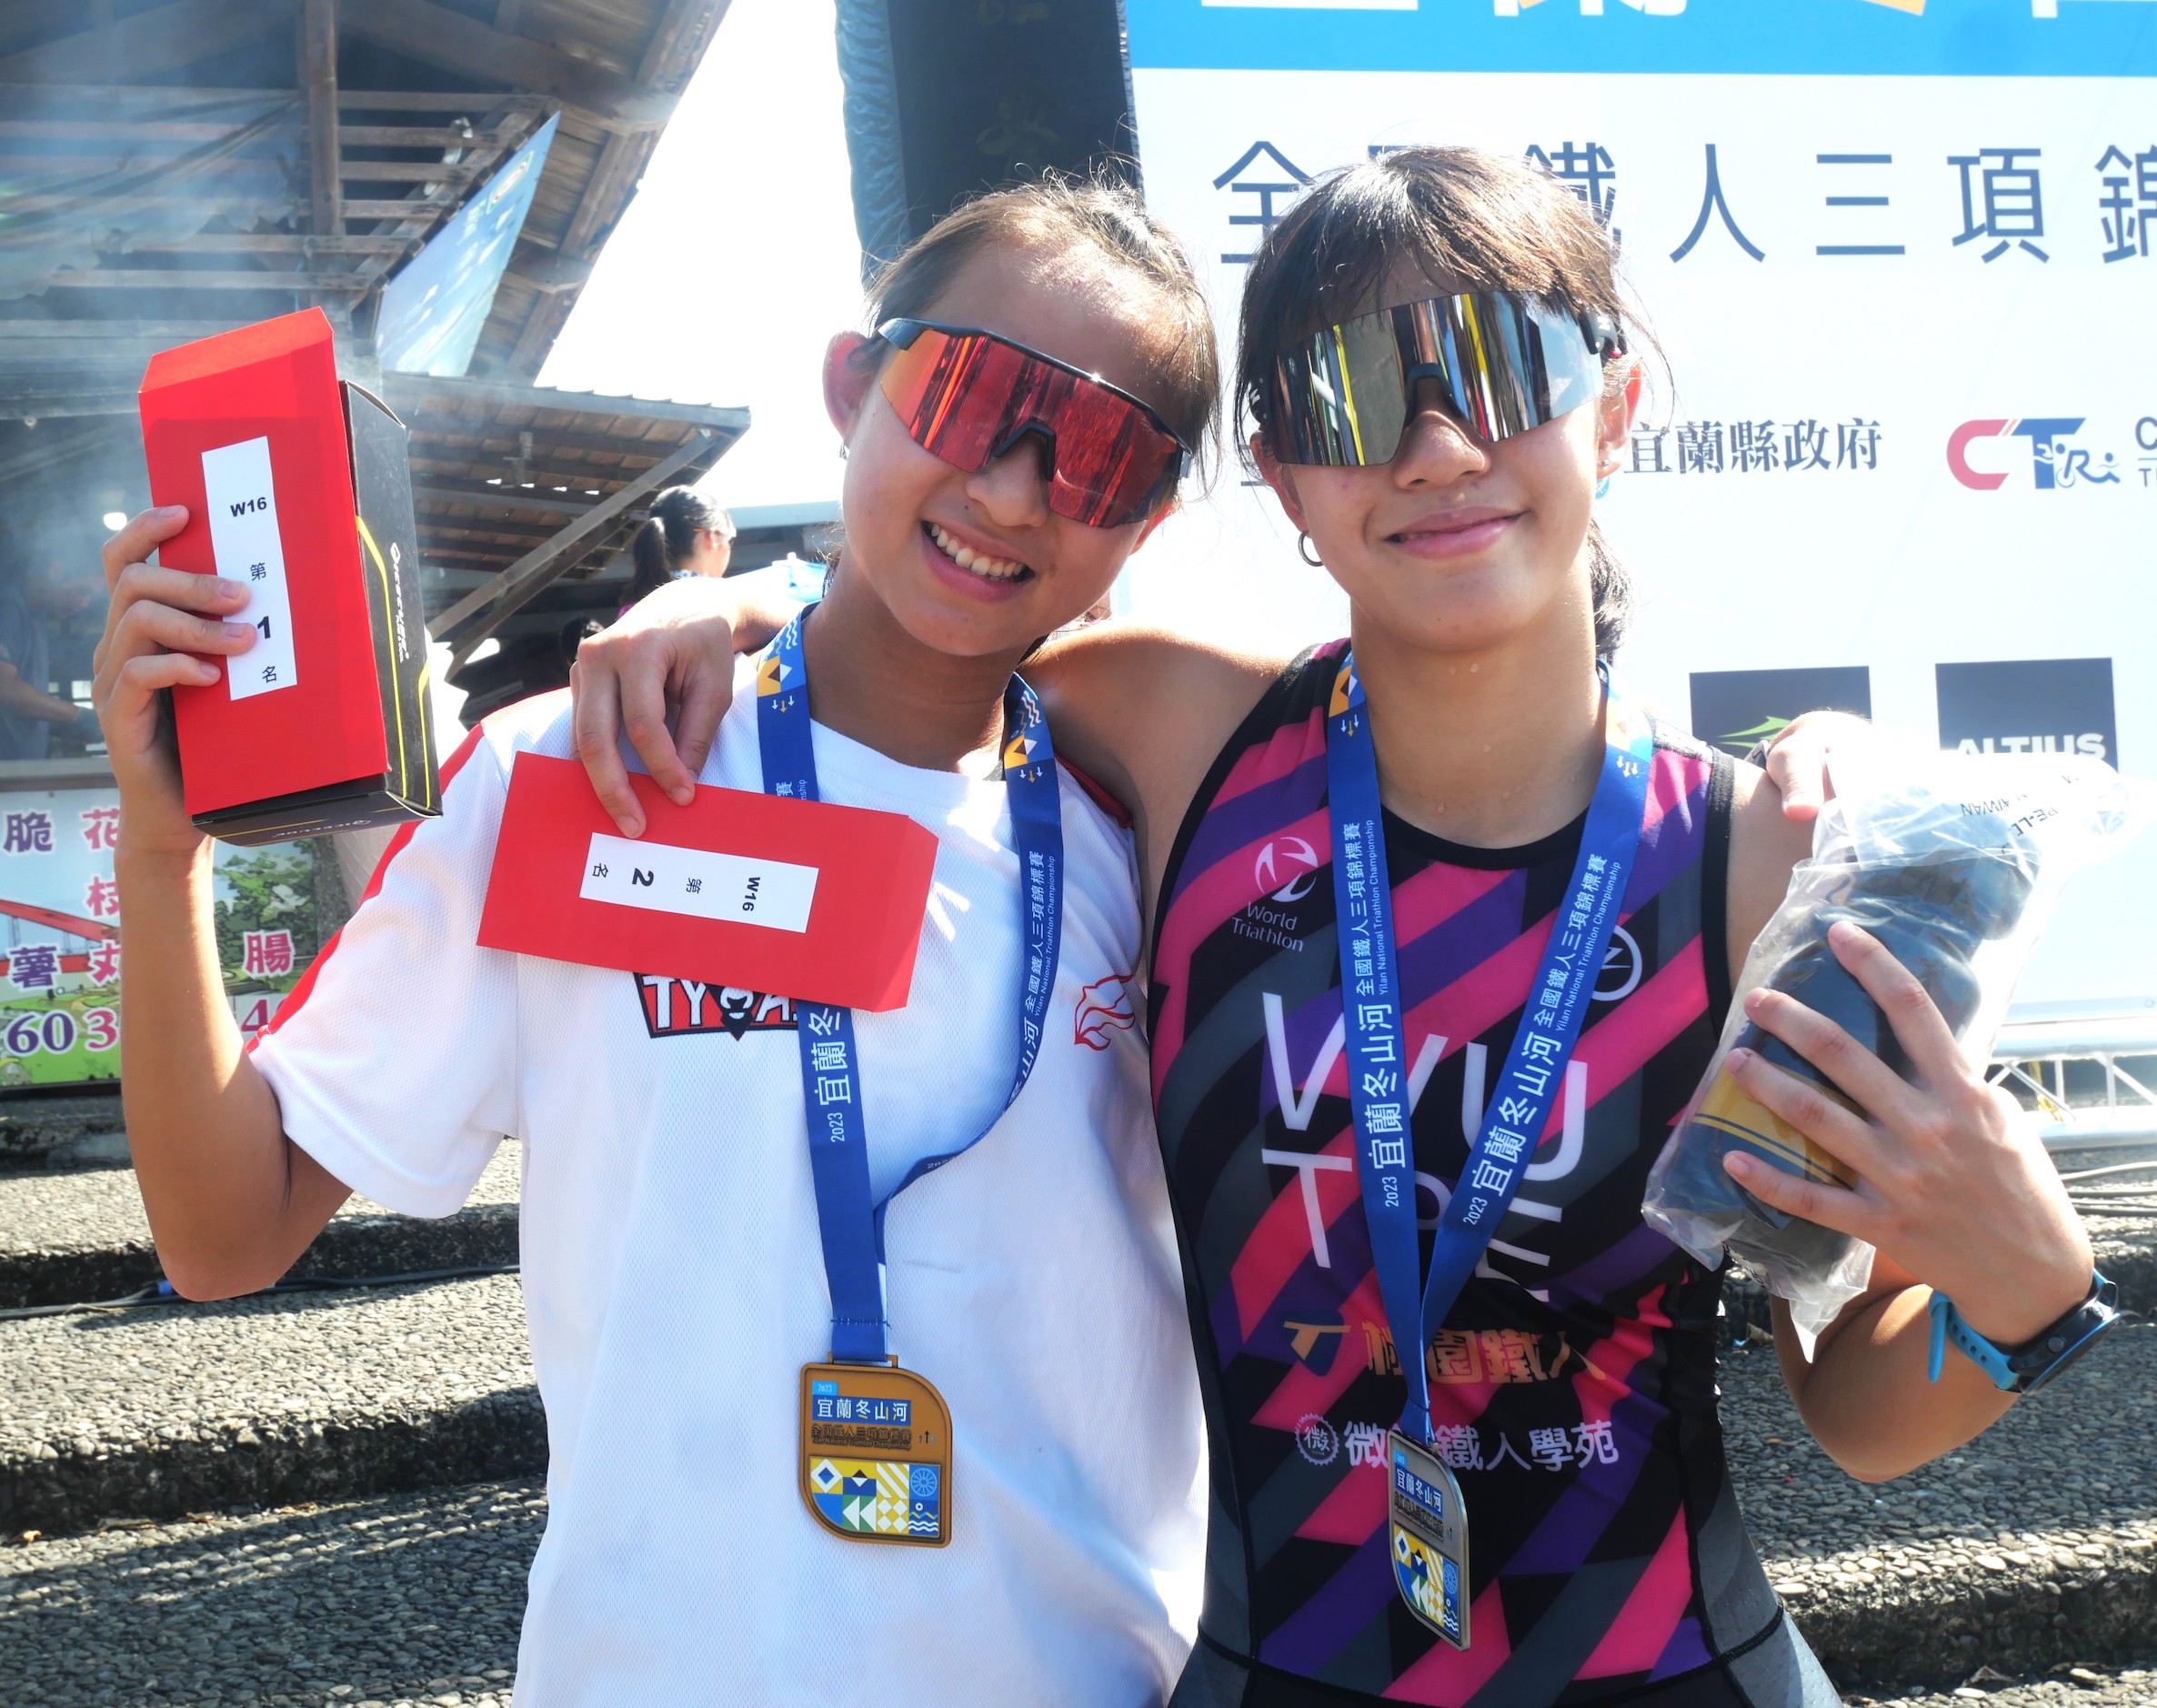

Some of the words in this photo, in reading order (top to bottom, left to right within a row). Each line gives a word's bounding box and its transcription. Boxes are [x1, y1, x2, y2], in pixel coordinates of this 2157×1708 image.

[1623, 417, 1883, 474] 宜蘭縣政府
[230, 496, 268, 517] W16
[250, 563, 266, 580] 第
[257, 616, 271, 639] 1
[262, 666, 277, 683] 名
[591, 862, 608, 878] 名
[1365, 819, 1379, 885] Championship
[631, 869, 655, 888] 2
[686, 876, 703, 894] 第
[740, 875, 762, 913] W16
[1047, 855, 1056, 915] Championship
[1247, 901, 1298, 931] World
[1343, 822, 1375, 997] 全國鐵人三項錦標賽
[1371, 887, 1382, 929] Triathlon
[1025, 850, 1045, 1013] 全國鐵人三項錦標賽
[1046, 916, 1054, 955] Triathlon
[1232, 917, 1304, 952] Triathlon
[1374, 930, 1387, 970] National
[1533, 853, 1607, 1029] 全國鐵人三項錦標賽
[1555, 1010, 1571, 1031] Yilan
[1564, 968, 1586, 1008] National
[1578, 927, 1600, 967] Triathlon
[1592, 861, 1621, 925] Championship
[245, 932, 293, 976] 腸
[1040, 955, 1052, 995] National
[1379, 971, 1389, 996] Yilan
[241, 999, 285, 1032] 4
[1034, 995, 1046, 1017] Yilan
[7, 1010, 75, 1053] 60
[1358, 1003, 1406, 1170] 宜蘭冬山河
[829, 1110, 845, 1143] 2023
[1471, 1030, 1562, 1198] 宜蘭冬山河
[1384, 1176, 1400, 1208] 2023
[1462, 1196, 1489, 1227] 2023
[817, 1397, 908, 1422] 宜蘭冬山河
[1344, 1419, 1620, 1472] 微鐵人學苑
[1396, 1468, 1442, 1512] 宜蘭冬山河
